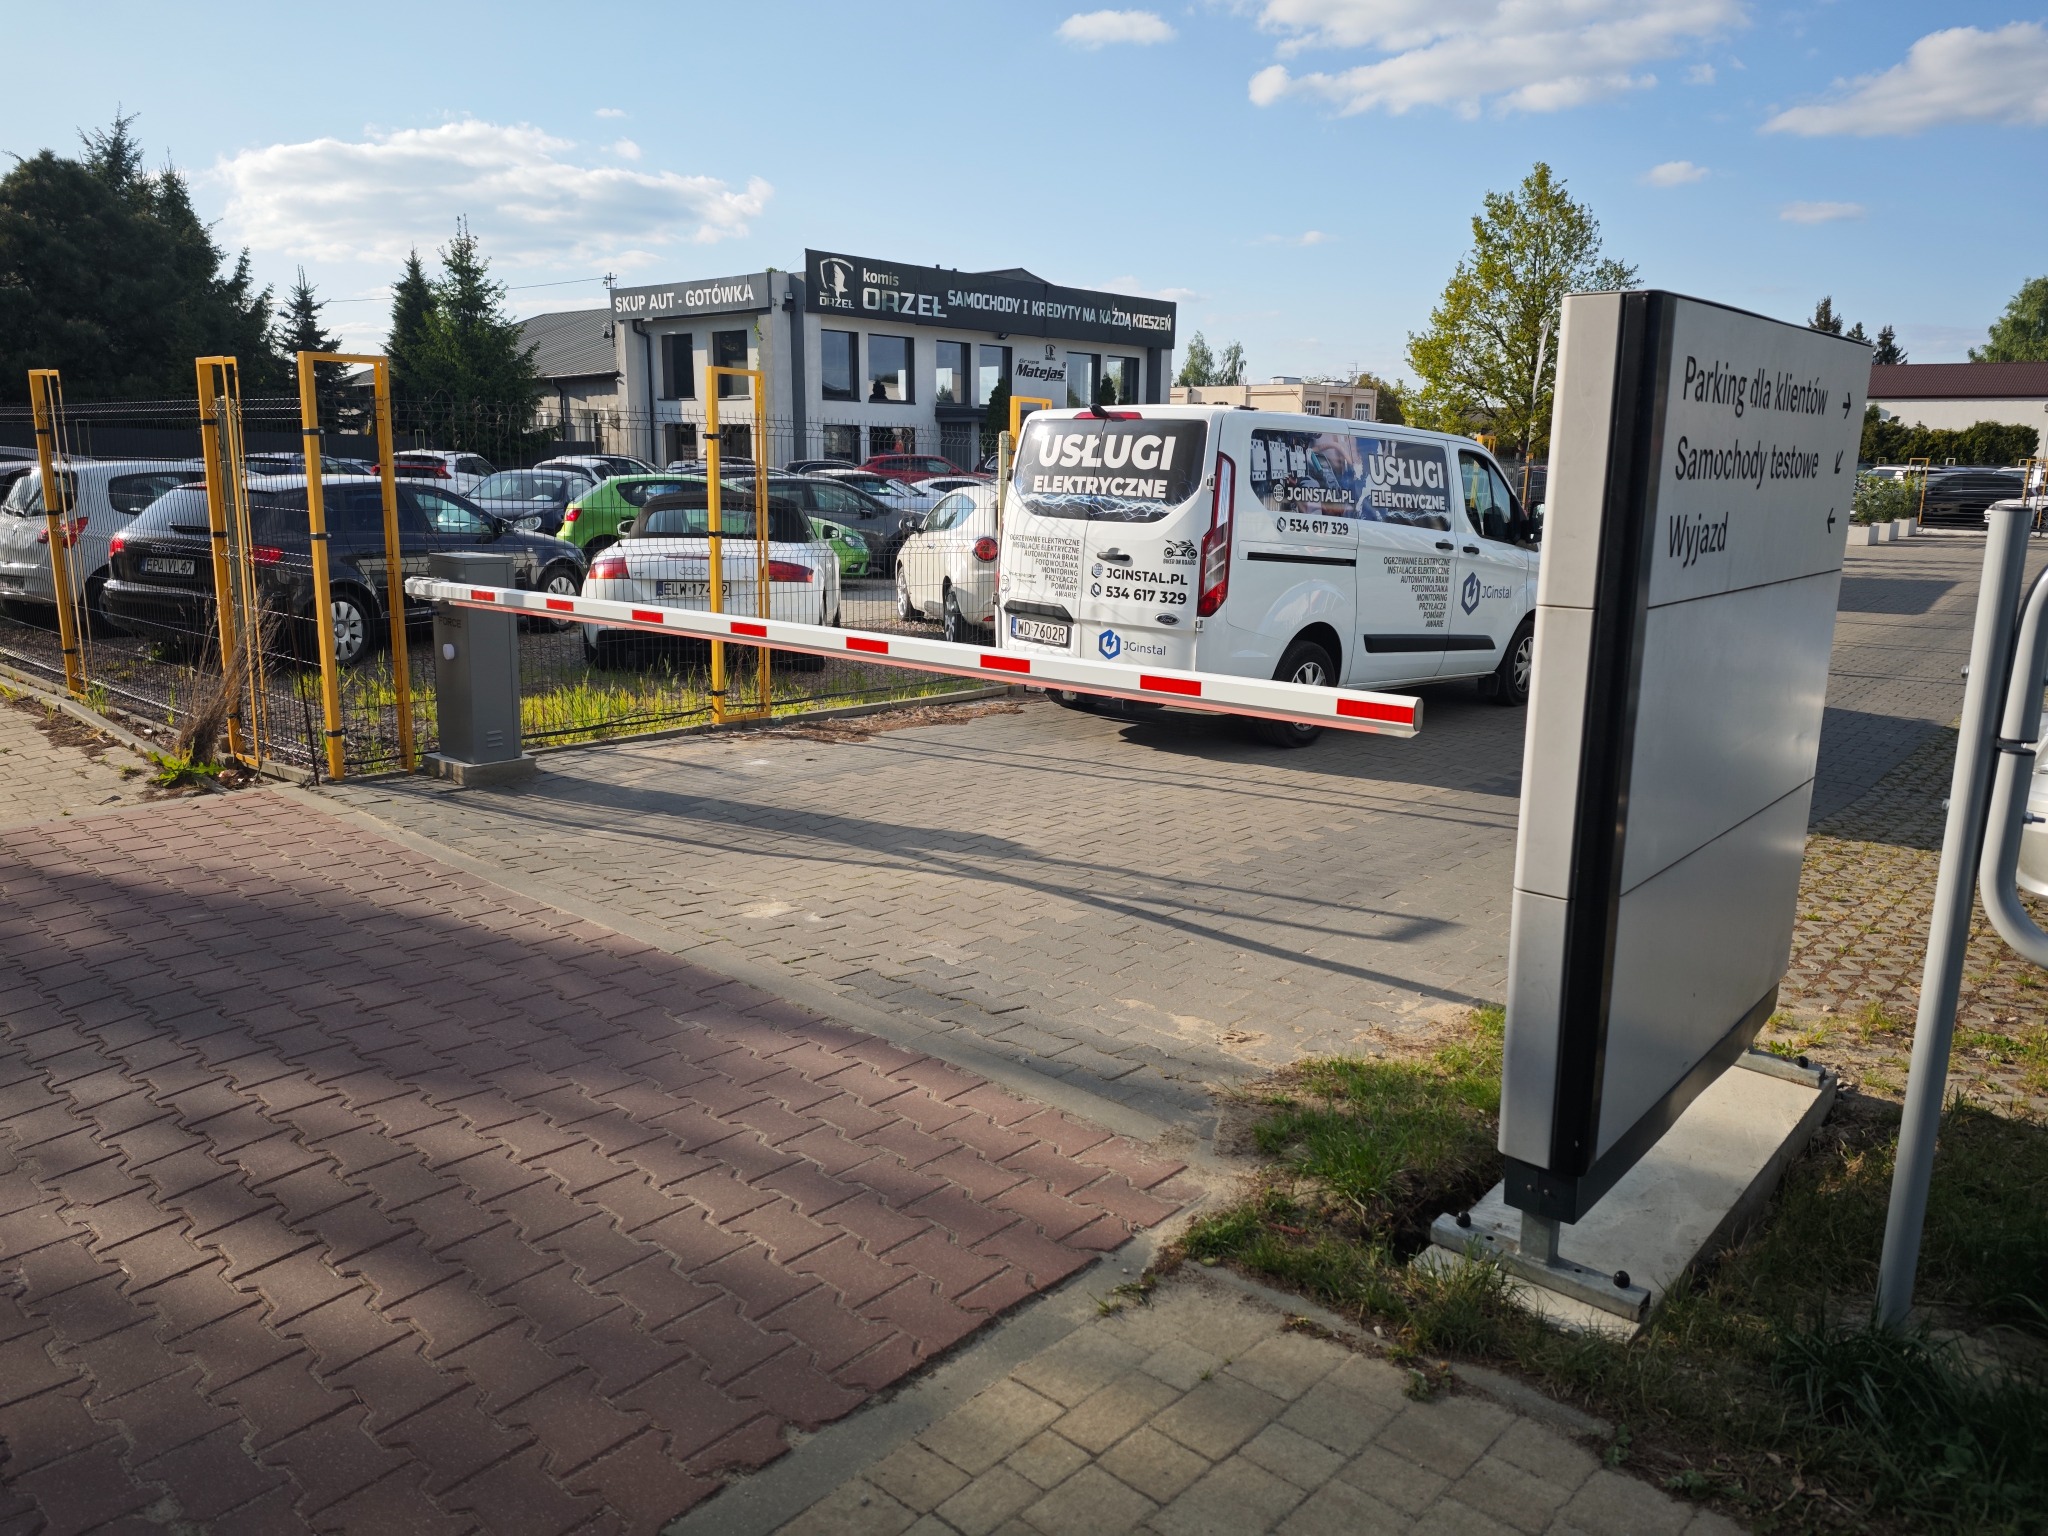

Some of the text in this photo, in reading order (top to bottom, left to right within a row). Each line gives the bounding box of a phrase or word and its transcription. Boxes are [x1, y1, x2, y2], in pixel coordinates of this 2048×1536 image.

[863, 268, 899, 286] komis
[615, 295, 646, 313] SKUP
[649, 292, 675, 310] AUT
[685, 283, 755, 307] GOTÓWKA
[862, 288, 948, 318] ORZEŁ
[947, 289, 1172, 332] SAMOCHODY I KREDYTY NA KAŻDĄ KIESZEŃ
[1015, 363, 1065, 382] Matejas
[1683, 356, 1828, 418] Parking dla klientów
[1038, 433, 1177, 470] USŁUGI
[1368, 454, 1445, 489] USŁUGI
[1675, 436, 1819, 490] Samochody testowe
[1032, 475, 1168, 499] ELEKTRYCZNE
[1287, 486, 1355, 504] JGINSTAL.PL
[1371, 490, 1446, 511] ELEKTRYCZNE
[1289, 518, 1349, 535] 534 617 329
[1010, 533, 1080, 546] OGRZEWANIE ELEKTRYCZNE
[1669, 511, 1729, 568] Wyjazd
[1024, 550, 1079, 561] AUTOMATYKA BRAM
[1041, 544, 1080, 554] ELEKTRYCZNE
[1035, 558, 1079, 569] FOTOWOLTAIKA
[1383, 556, 1451, 566] OGRZEWANIE ELEKTRYCZNE
[1387, 566, 1417, 574] INSTALACJE
[1041, 566, 1078, 576] MONITORING
[1106, 567, 1188, 585] JGINSTAL.PL
[1400, 575, 1449, 584] AUTOMATYKA BRAM
[664, 583, 728, 596] ELW 1749
[1051, 582, 1078, 591] POMIARY
[1054, 590, 1077, 599] AWARIE
[1105, 586, 1187, 605] 534 617 329
[1411, 584, 1448, 593] FOTOWOLTAIKA
[1481, 585, 1513, 599] JGinstal
[1018, 621, 1065, 641] WD 7602R
[1123, 641, 1167, 656] JGinstal
